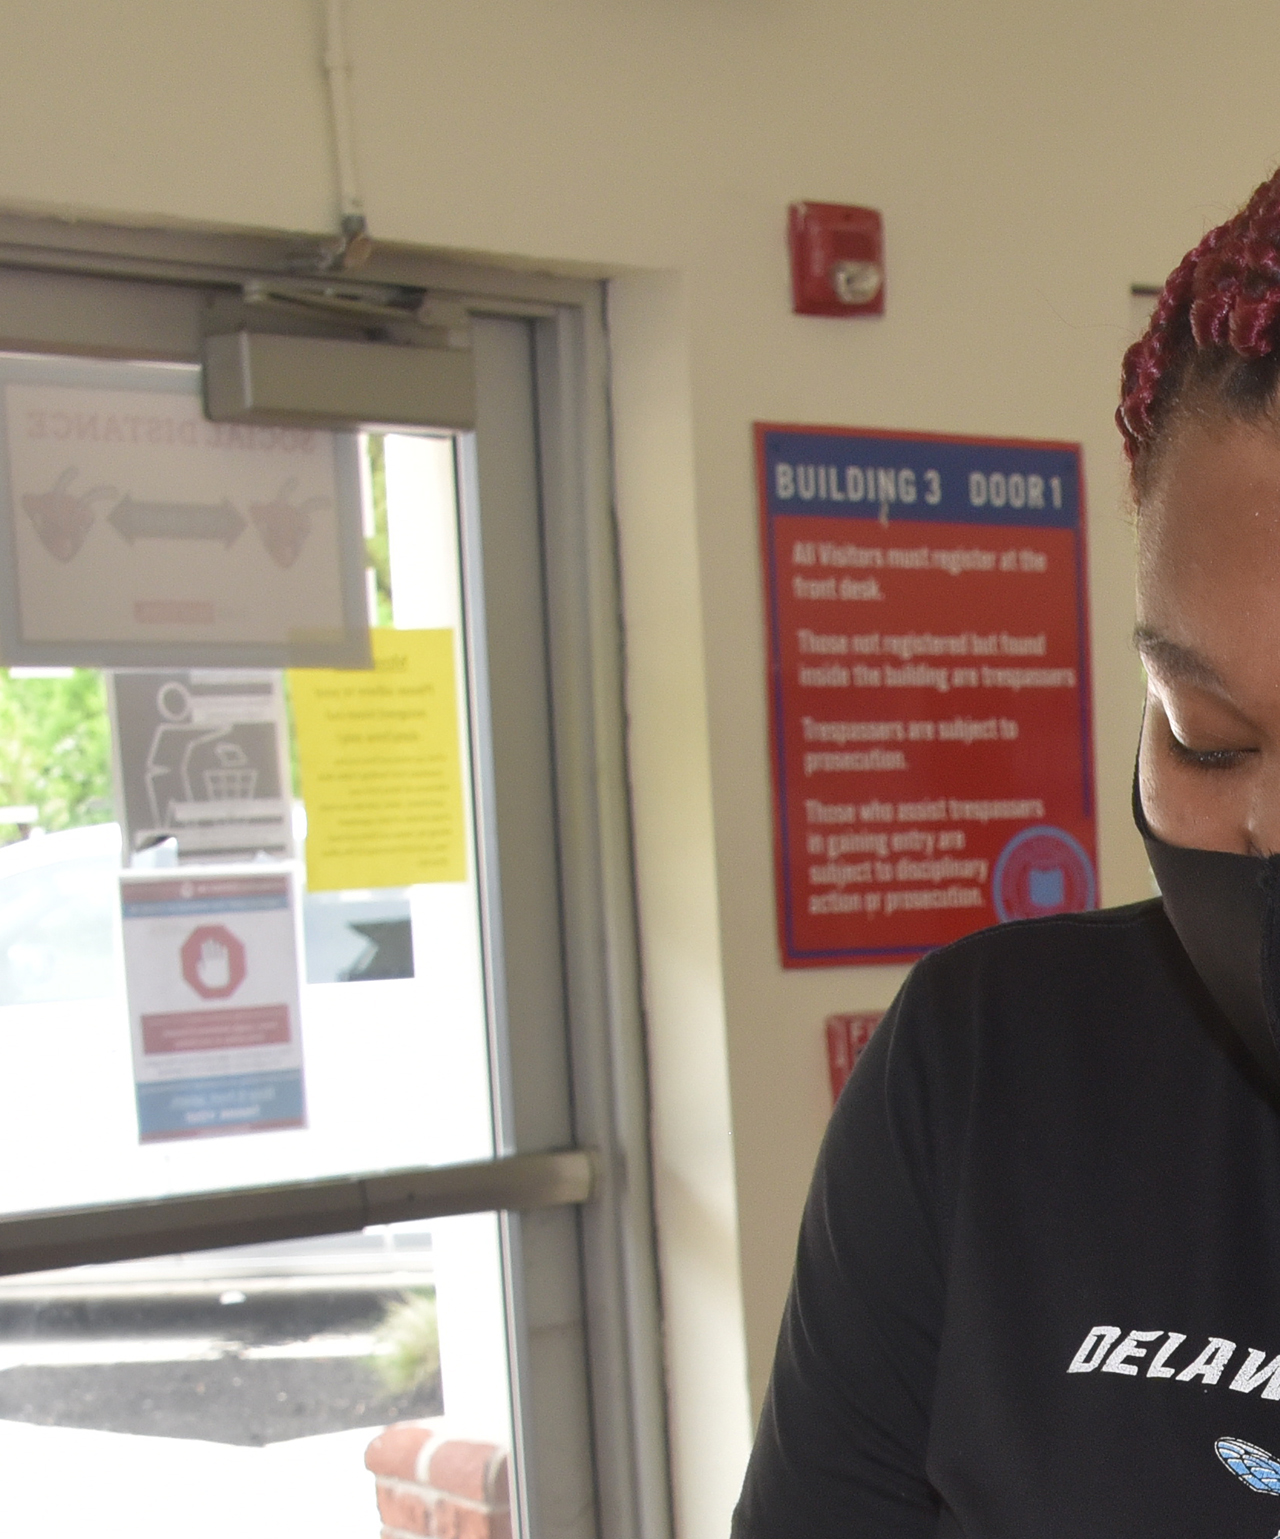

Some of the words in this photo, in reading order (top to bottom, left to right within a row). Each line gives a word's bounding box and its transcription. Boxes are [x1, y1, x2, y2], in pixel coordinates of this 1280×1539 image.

[775, 462, 917, 504] BUILDING
[924, 468, 942, 505] 3
[968, 471, 1045, 510] DOOR
[1050, 475, 1062, 510] 1
[792, 541, 817, 567] All
[818, 541, 884, 569] Visitors
[888, 546, 929, 569] must
[930, 546, 997, 576] register
[1000, 549, 1017, 572] at
[1018, 548, 1048, 573] the
[792, 576, 837, 600] front
[797, 628, 848, 655] Those
[852, 630, 880, 655] not
[882, 631, 967, 661] registered
[972, 630, 998, 656] but
[999, 629, 1047, 656] found
[798, 661, 850, 688] inside
[852, 662, 881, 688] the
[882, 662, 949, 693] building
[952, 667, 979, 688] are
[981, 664, 1077, 693] trespassers
[802, 715, 905, 746] Trespassers
[907, 720, 936, 741] are
[937, 714, 998, 746] subject
[1000, 716, 1019, 741] to
[803, 749, 909, 777] prosecution.
[804, 798, 856, 823] Those
[859, 799, 894, 823] who
[896, 796, 946, 822] assist
[947, 796, 1046, 824] trespassers
[805, 830, 825, 855] in
[826, 829, 889, 860] gaining
[891, 830, 936, 856] entry
[937, 830, 966, 852] are
[809, 860, 873, 890] subject
[874, 860, 894, 883] to
[895, 857, 989, 885] disciplinary
[808, 890, 861, 915] action
